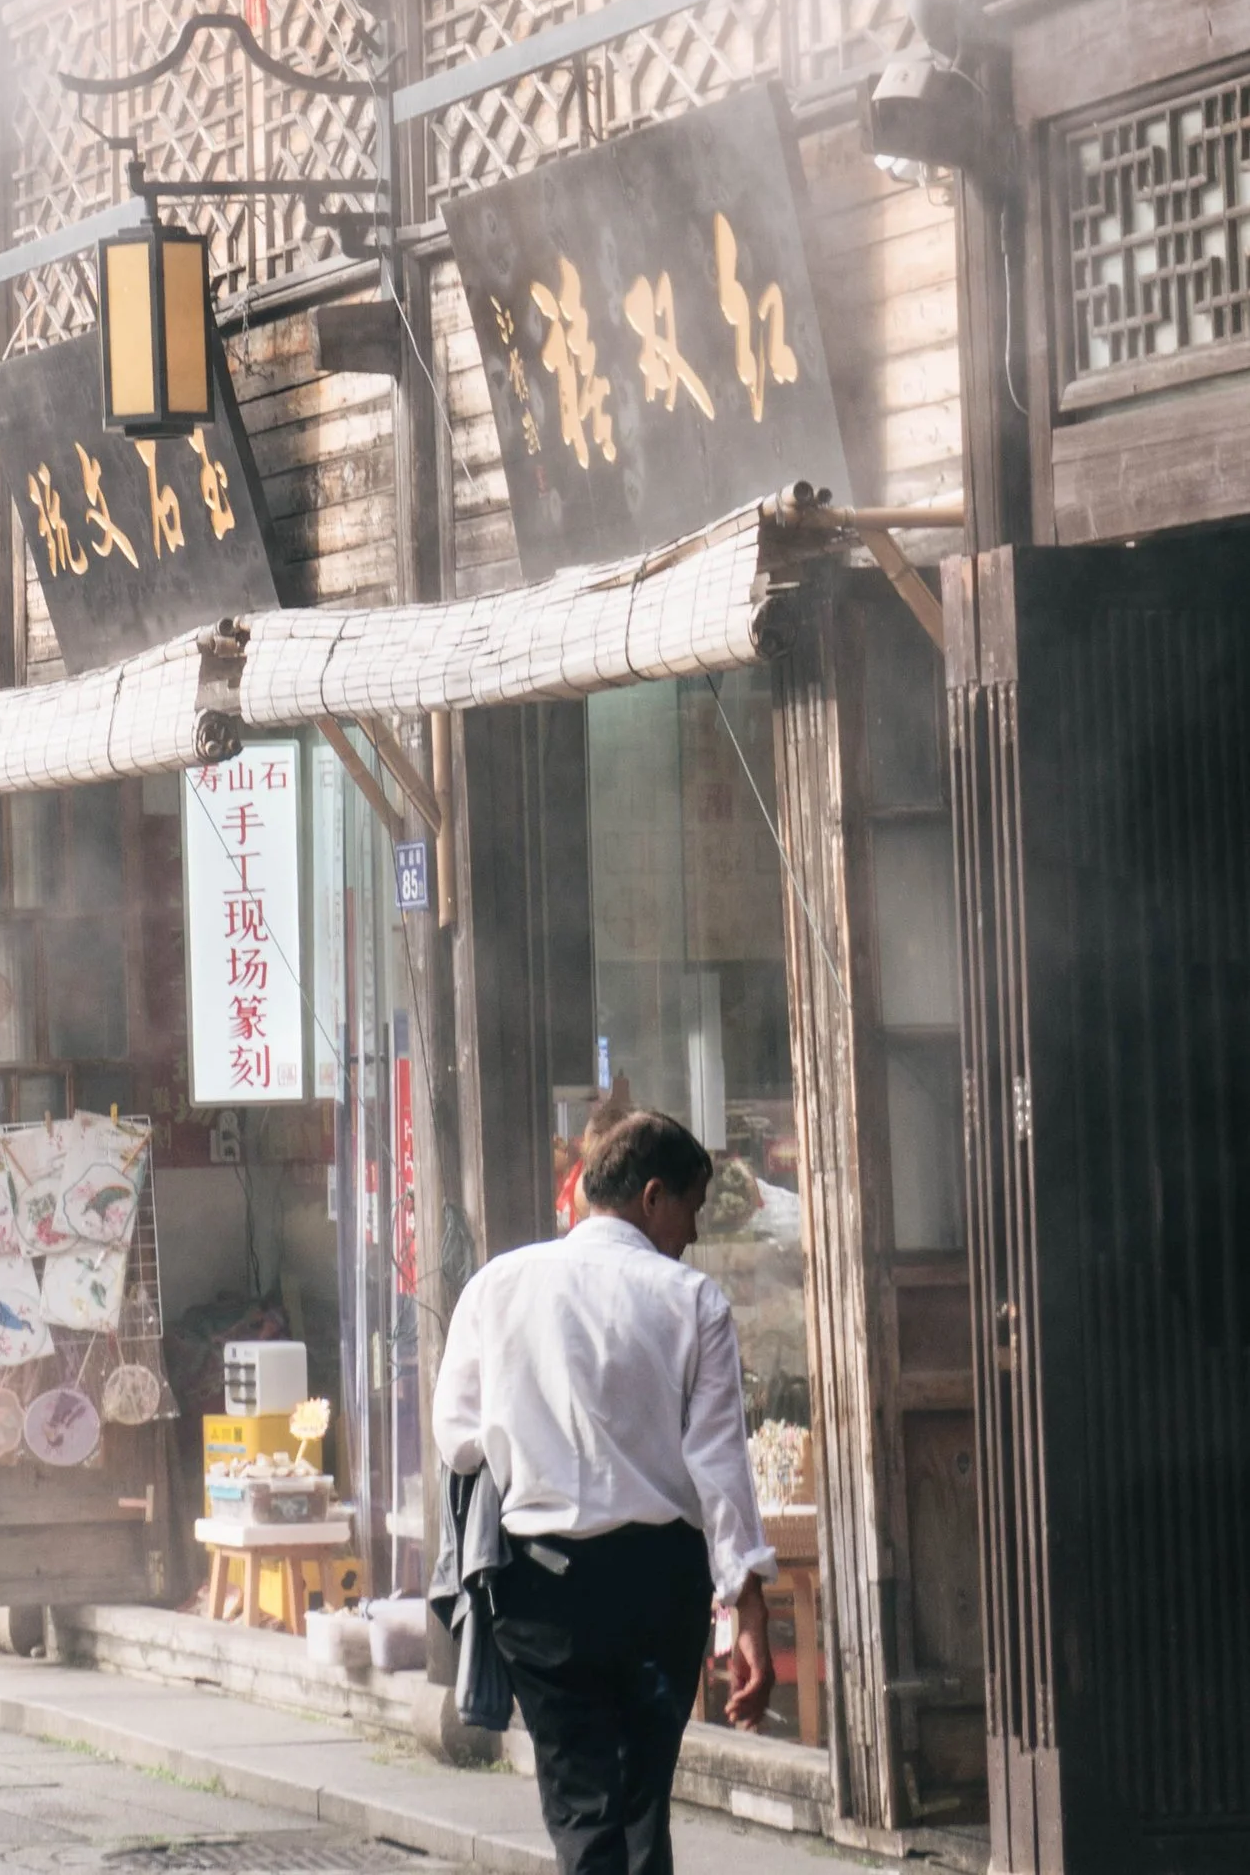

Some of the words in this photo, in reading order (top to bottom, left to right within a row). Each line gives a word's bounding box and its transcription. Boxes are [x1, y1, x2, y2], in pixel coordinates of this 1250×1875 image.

[193, 760, 290, 793] 寿山石
[221, 802, 271, 1091] 手工现场篆刻
